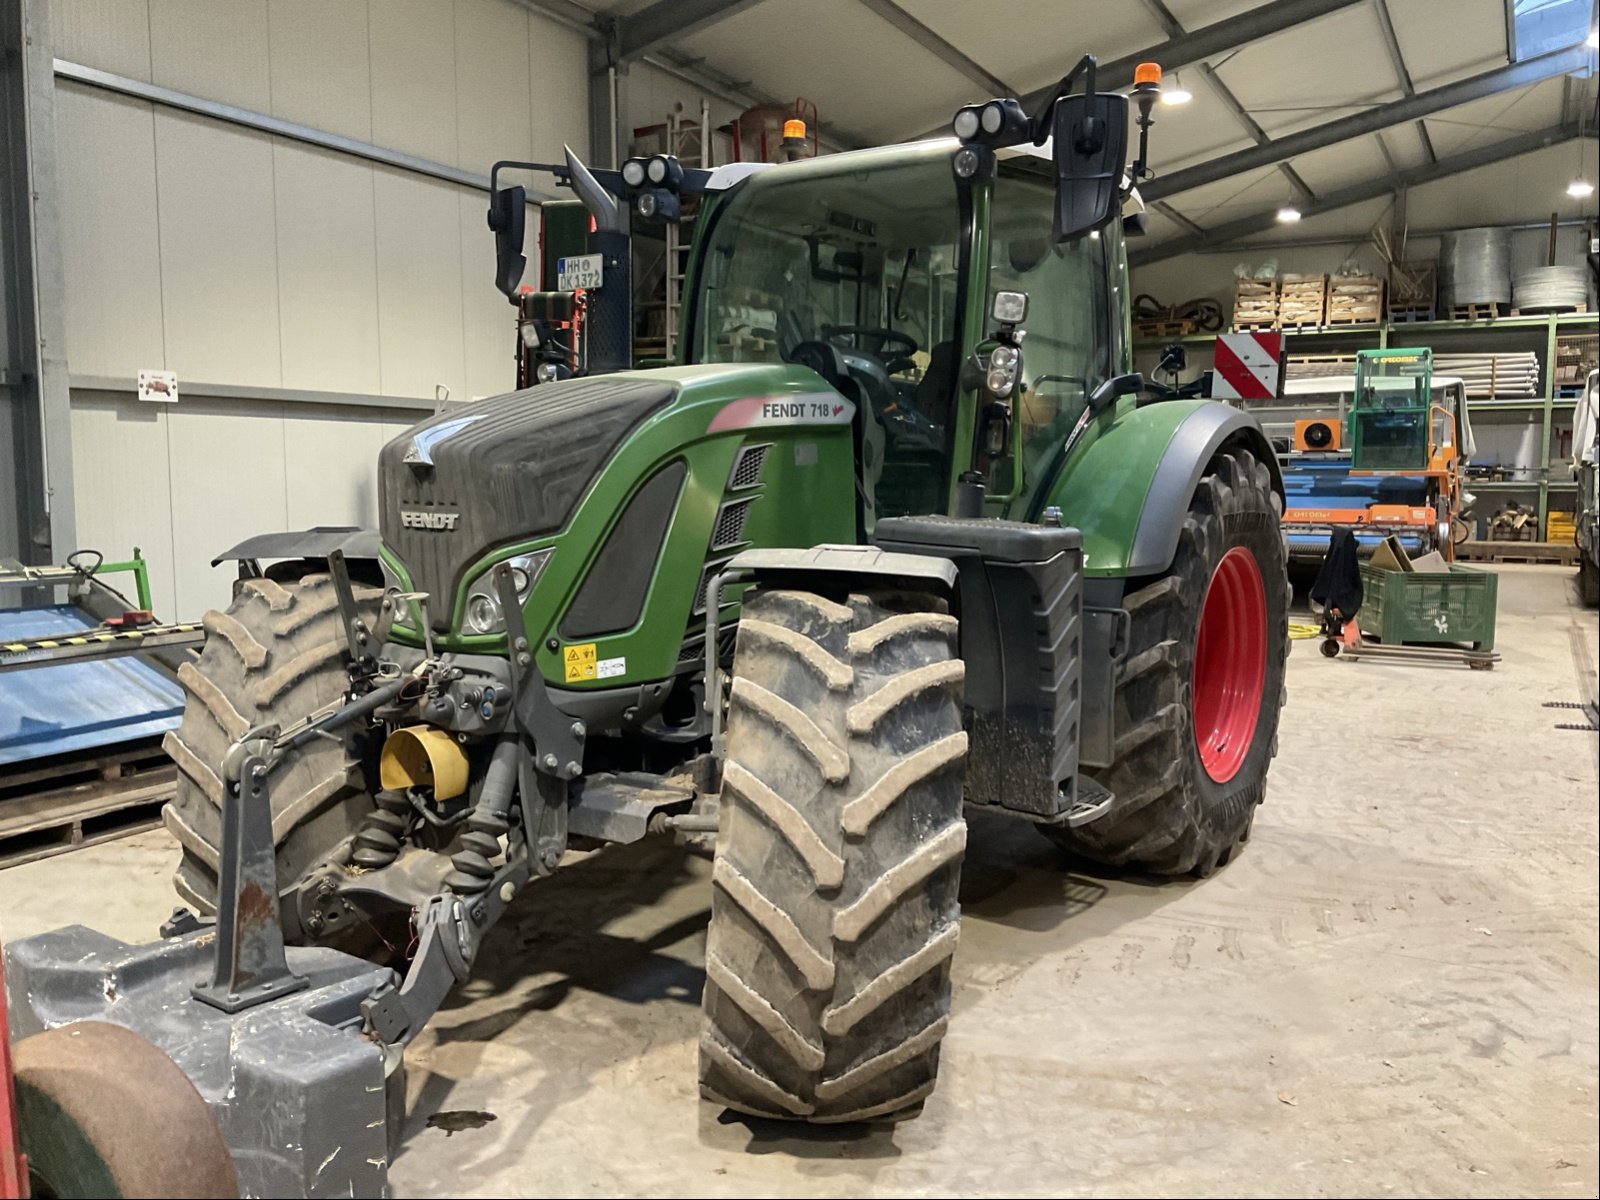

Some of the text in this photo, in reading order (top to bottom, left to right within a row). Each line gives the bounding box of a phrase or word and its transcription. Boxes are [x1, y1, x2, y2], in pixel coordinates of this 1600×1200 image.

[567, 259, 580, 273] HH
[575, 270, 600, 288] 1372
[763, 403, 806, 418] FENDT
[810, 403, 829, 417] 718
[401, 511, 460, 530] FENDT
